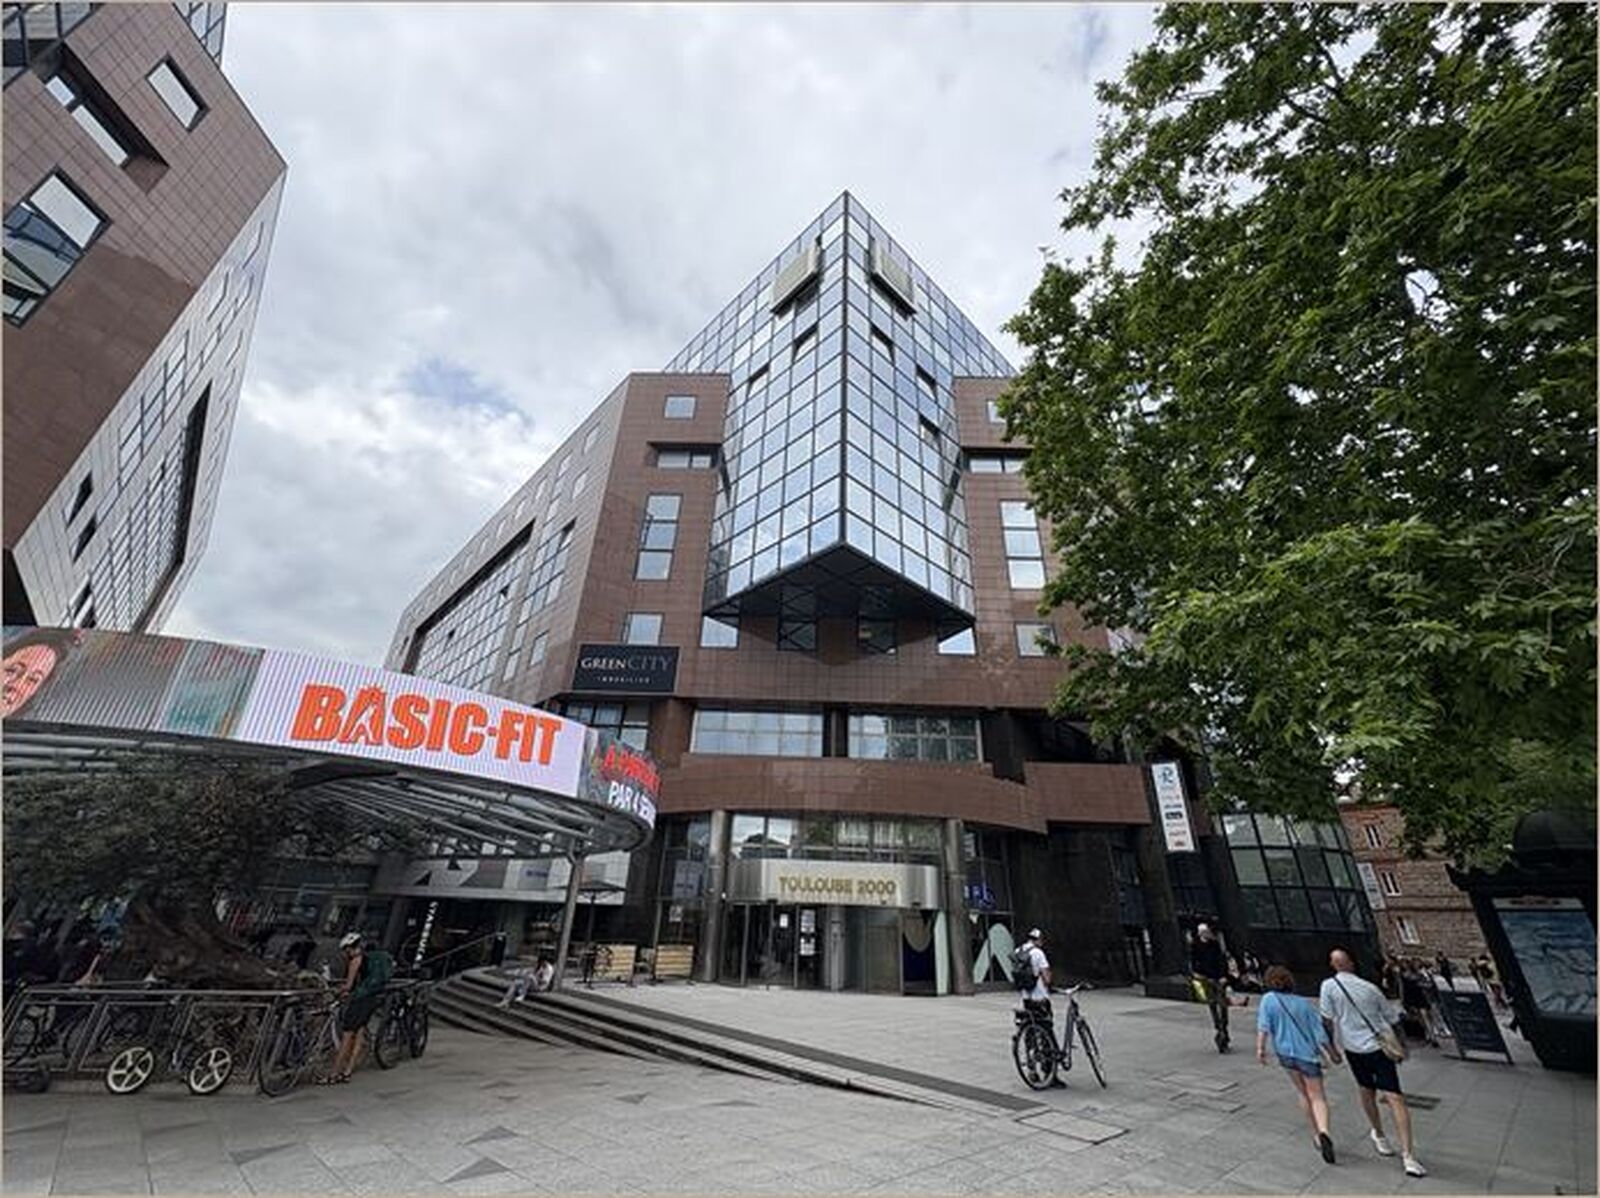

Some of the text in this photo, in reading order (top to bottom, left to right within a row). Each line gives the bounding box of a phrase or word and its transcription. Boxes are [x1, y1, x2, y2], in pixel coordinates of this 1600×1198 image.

[291, 685, 561, 765] BASIC-FIT
[779, 876, 897, 895] TOULOUSE 2000
